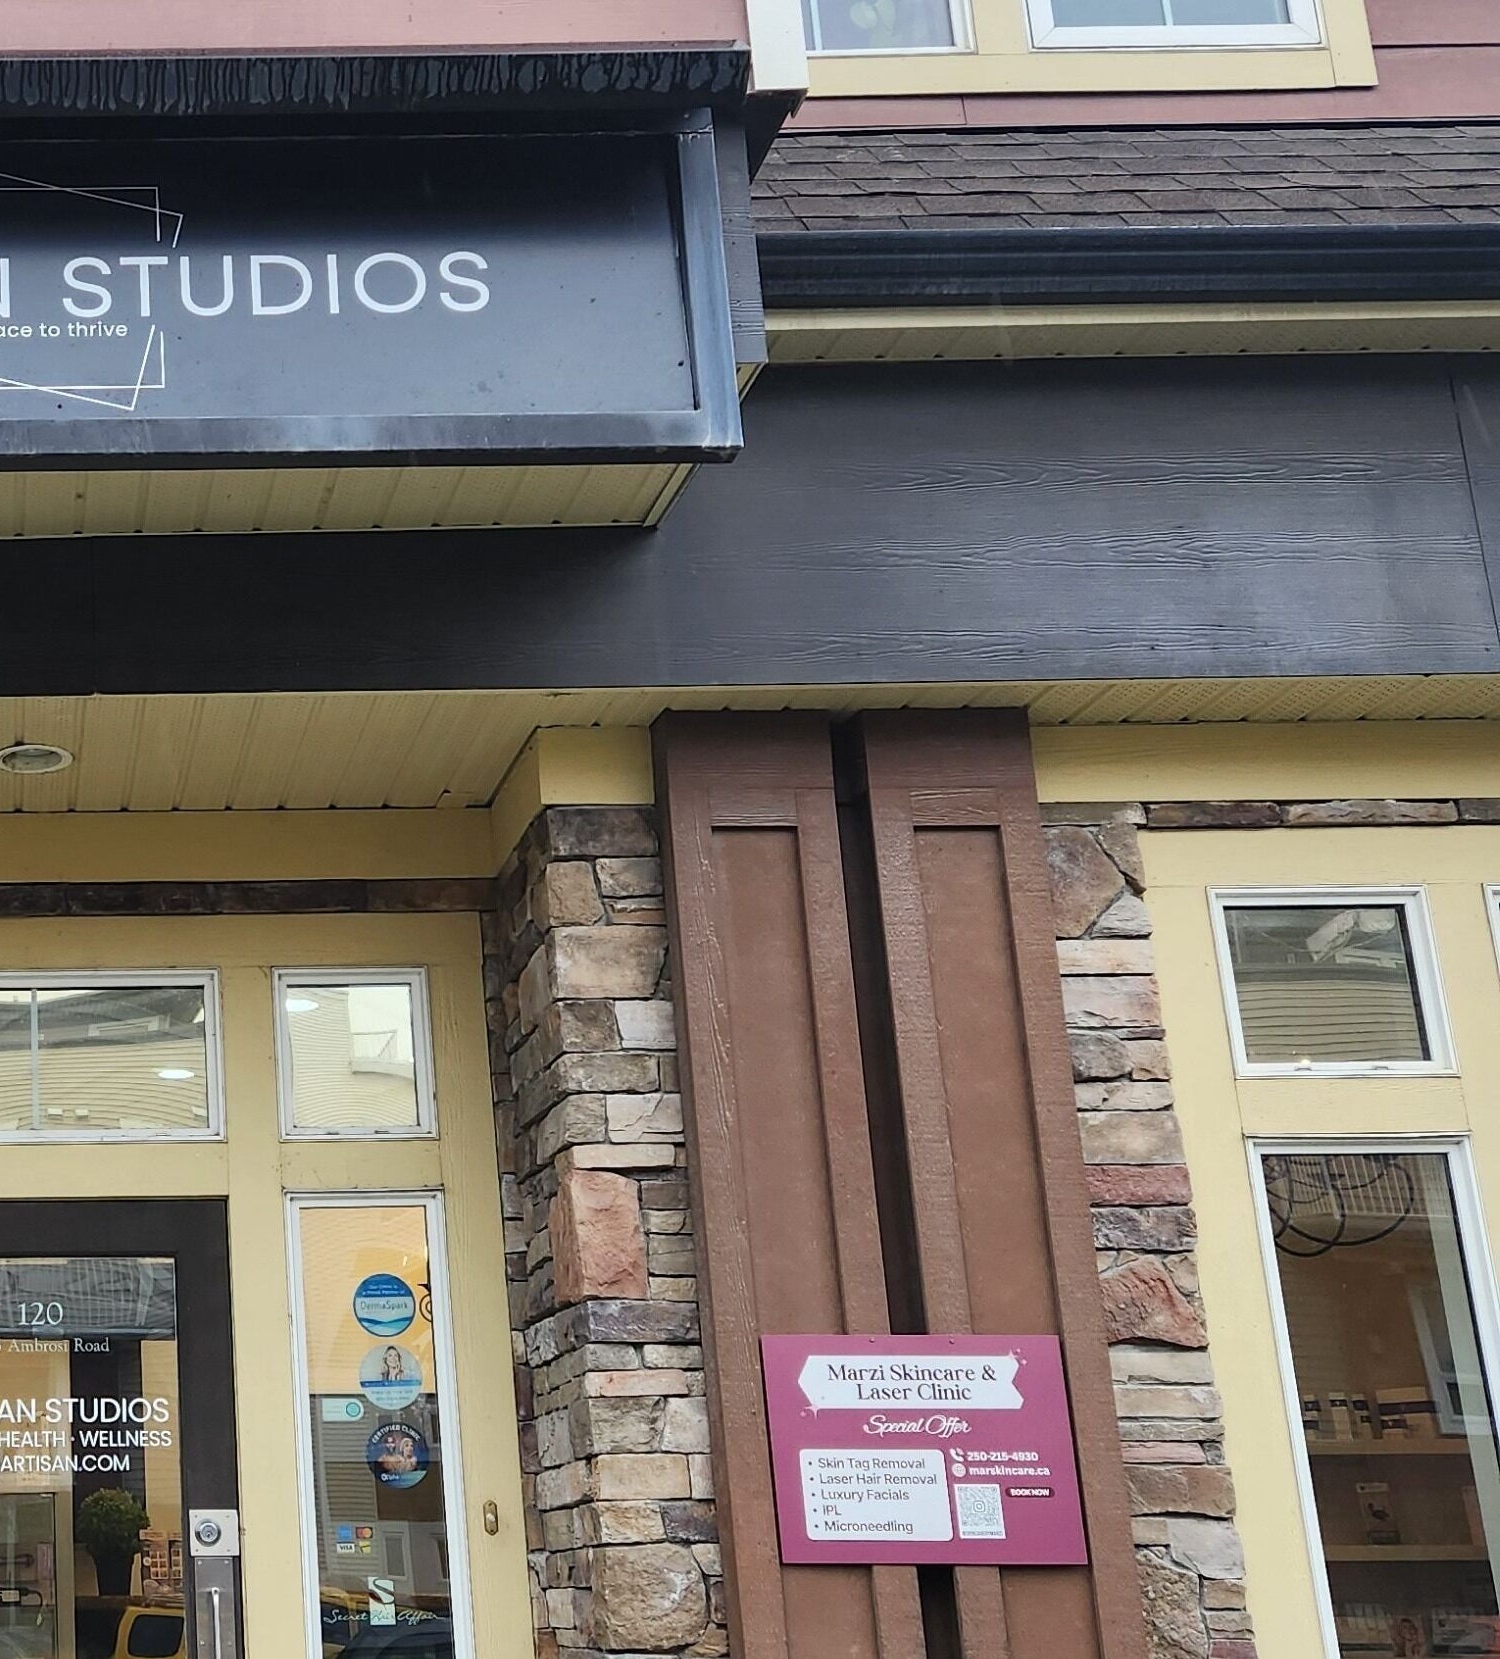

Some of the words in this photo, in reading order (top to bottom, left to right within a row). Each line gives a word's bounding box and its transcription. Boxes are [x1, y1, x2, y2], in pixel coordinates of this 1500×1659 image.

[62, 251, 491, 318] STUDIOS
[39, 322, 61, 338] to
[68, 320, 129, 338] thrive
[17, 1301, 64, 1326] 120
[360, 1299, 408, 1311] DermaSpark
[8, 1337, 69, 1353] Ambrosi
[73, 1336, 110, 1353] Road
[828, 1363, 886, 1381] Marzi
[890, 1363, 976, 1382] Skincare
[981, 1364, 997, 1381] &
[856, 1383, 913, 1401] Laser
[917, 1383, 973, 1401] Clinic
[45, 1397, 170, 1423] STUDIOS
[371, 1424, 401, 1444] CERTIFIED
[401, 1424, 421, 1442] CLINIC
[862, 1413, 926, 1438] Special
[924, 1413, 973, 1438] Offer
[78, 1430, 172, 1448] WELLNESS
[817, 1457, 845, 1469] Skin
[847, 1457, 870, 1472] Tag
[872, 1457, 926, 1470] Removal
[966, 1451, 1039, 1462] 250-215-4930
[818, 1472, 854, 1485] Laser
[856, 1472, 882, 1485] Hair
[884, 1472, 938, 1485] Removal
[968, 1464, 1051, 1476] marskincare.ca
[820, 1488, 864, 1503] Luxury
[866, 1488, 910, 1501] Facials
[1010, 1488, 1031, 1497] BOOK
[1031, 1488, 1050, 1497] NOW
[822, 1504, 842, 1516] IPL
[824, 1519, 914, 1535] Microneedling
[323, 1609, 368, 1624] Secret
[397, 1609, 444, 1626] Affair
